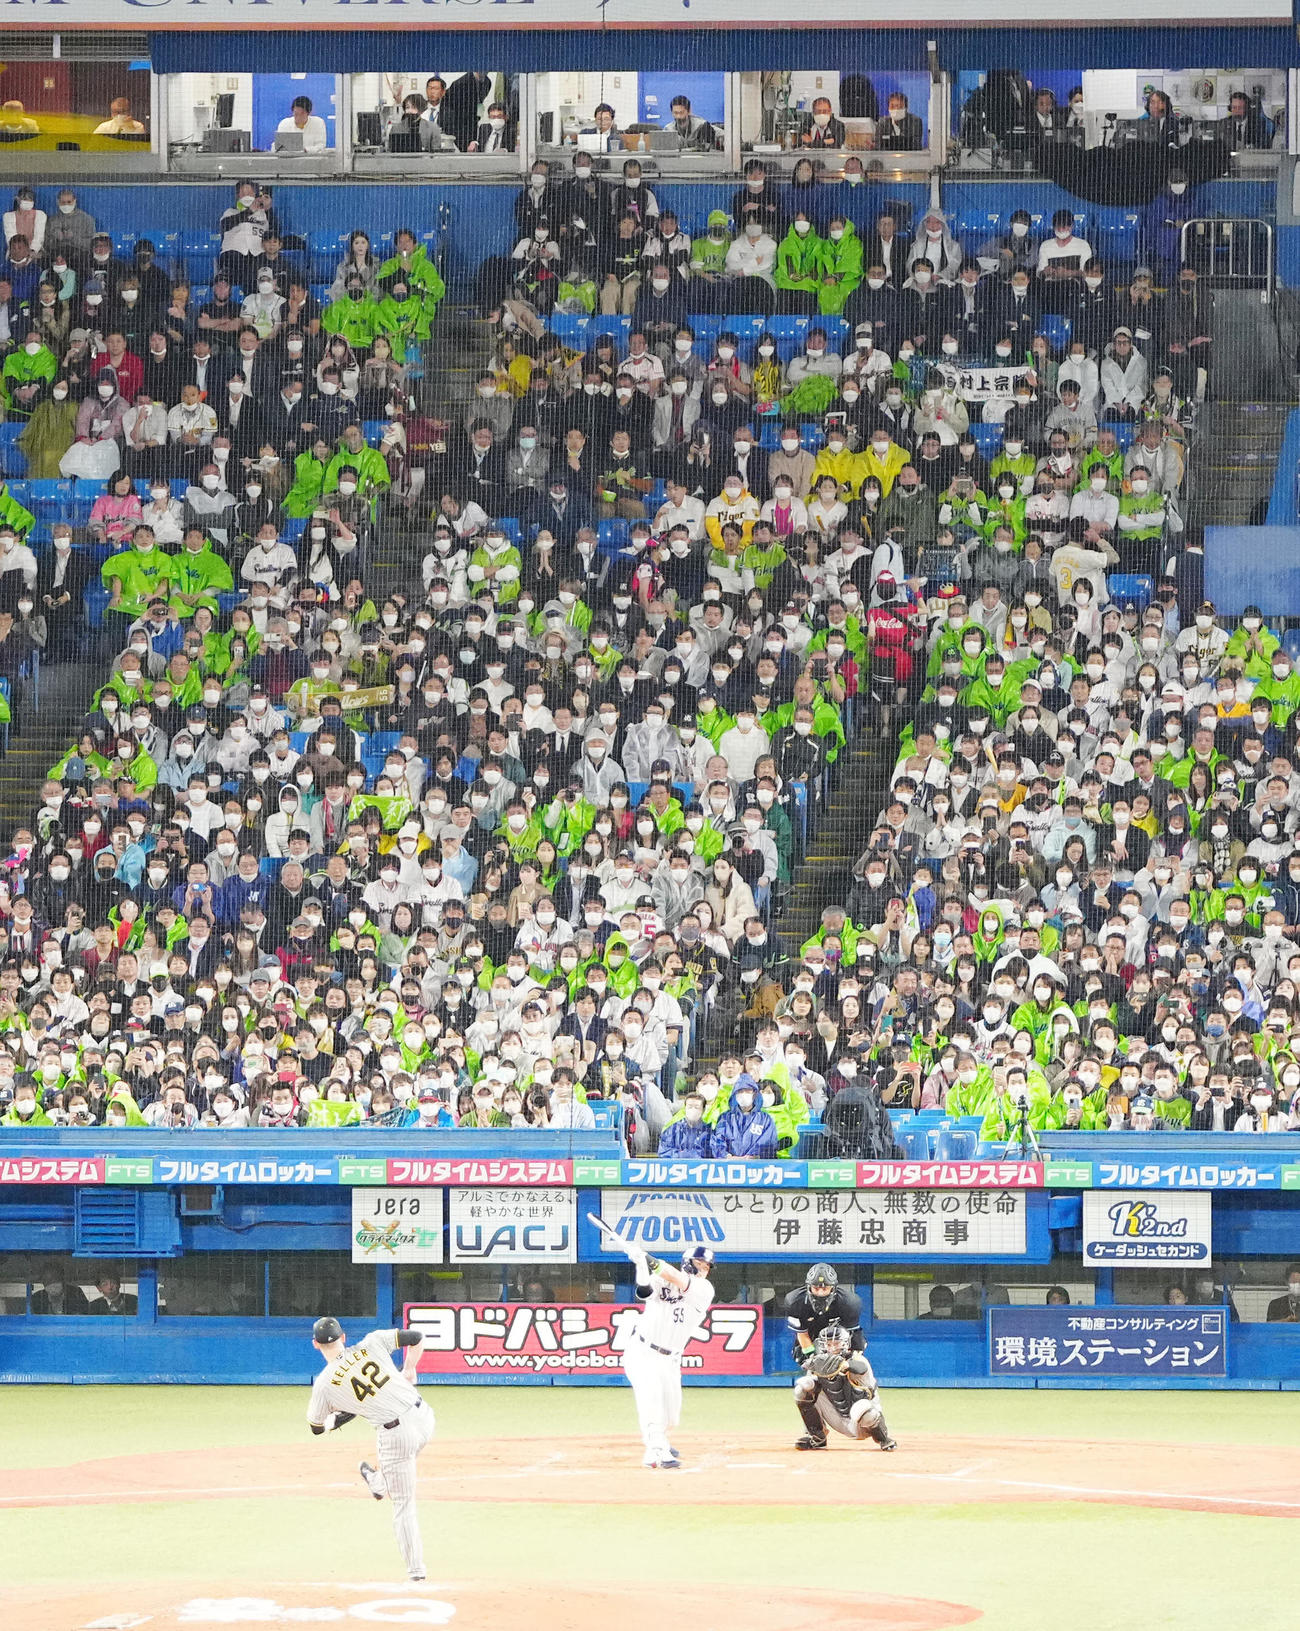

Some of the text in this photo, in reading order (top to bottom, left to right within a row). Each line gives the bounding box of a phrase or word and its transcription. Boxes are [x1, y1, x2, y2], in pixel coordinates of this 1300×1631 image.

[1060, 566, 1072, 590] 3
[0, 1161, 98, 1181] ムシステム
[107, 1165, 150, 1178] FTS
[159, 1161, 332, 1182] フルタイムロッカー
[341, 1165, 384, 1178] FTS
[392, 1162, 567, 1183] フルタイムシステム
[575, 1166, 618, 1179] FTS
[628, 1163, 801, 1185] フルタイムロッカー
[810, 1168, 854, 1181] FTS
[862, 1164, 1037, 1185] フルタイムシステム
[1046, 1168, 1090, 1181] FTS
[1099, 1164, 1274, 1187] フルタイムロッカー
[470, 1205, 553, 1218] 軽やかな世界
[723, 1190, 1018, 1215] ひとりの商人、無数の使命
[610, 1215, 726, 1243] ITOCHU
[773, 1218, 969, 1246] 伊藤忠商事
[456, 1225, 569, 1257] UACJ
[1093, 1243, 1200, 1258] ケーダッシュセカンド
[1067, 1317, 1200, 1331] 不動産コンサルティング
[995, 1336, 1219, 1367] 環境ステーション
[331, 1348, 369, 1387] KELLER
[350, 1361, 390, 1402] 42
